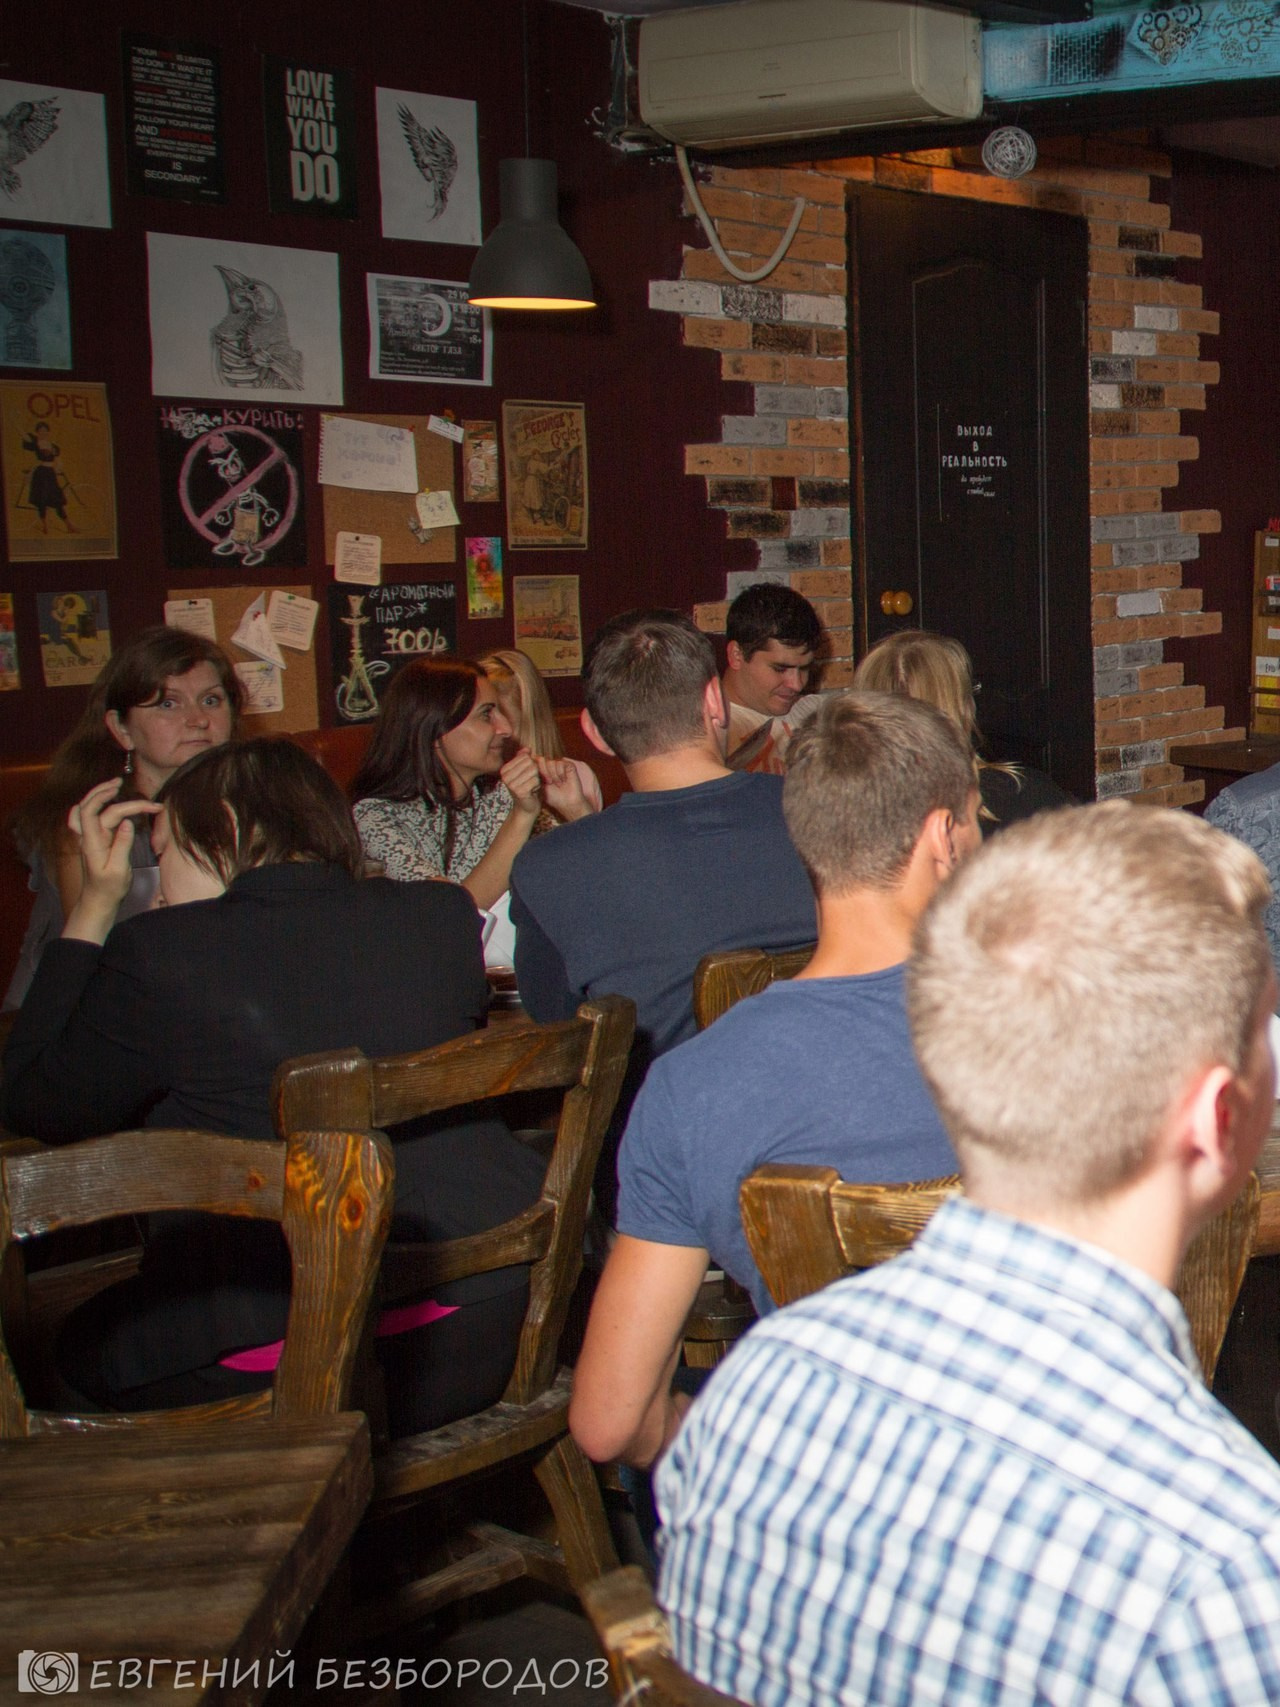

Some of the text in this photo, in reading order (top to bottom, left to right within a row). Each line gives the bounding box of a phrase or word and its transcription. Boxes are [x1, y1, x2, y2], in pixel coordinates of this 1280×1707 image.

[285, 67, 334, 100] LOVE
[286, 95, 335, 122] WHAT
[135, 124, 159, 136] AND
[287, 116, 338, 155] YOU
[172, 161, 182, 171] IS
[290, 150, 340, 203] DO
[27, 391, 100, 423] OPEL
[957, 424, 993, 437] ВЫХОД
[972, 440, 979, 452] В
[942, 455, 1008, 468] РЕАЛЬНОСТЬ
